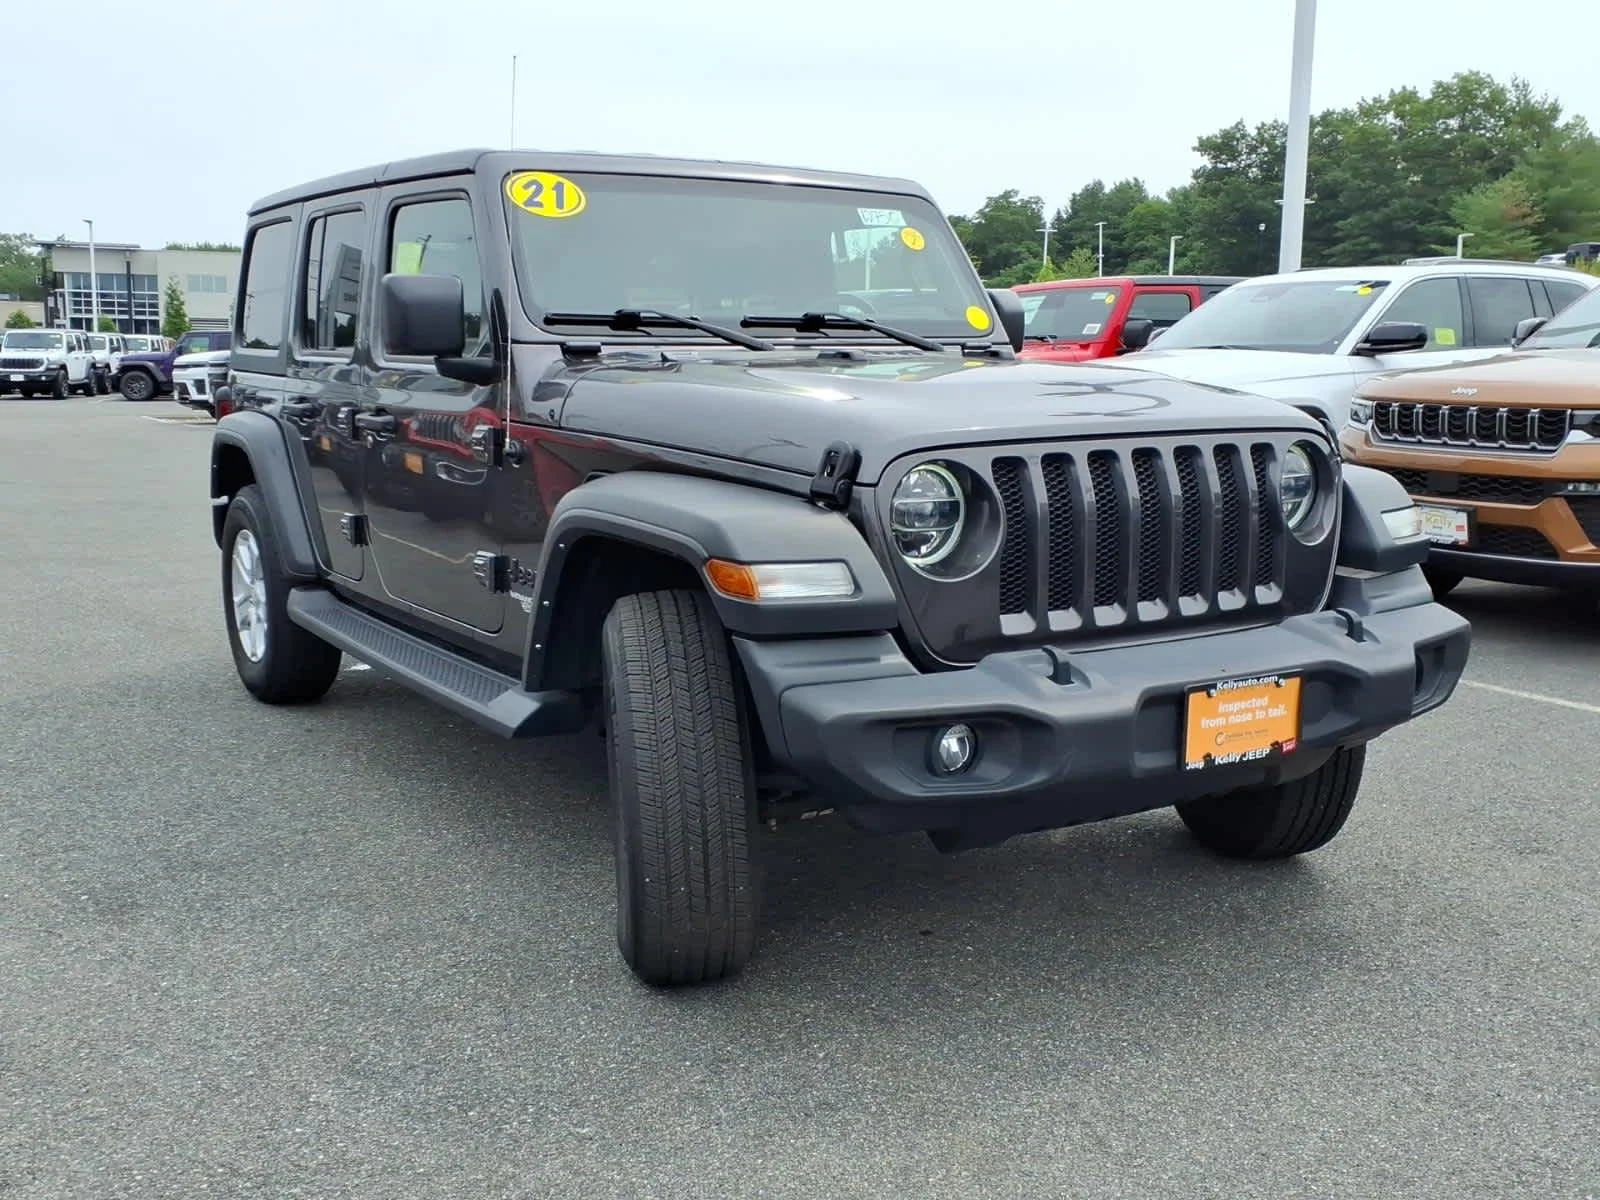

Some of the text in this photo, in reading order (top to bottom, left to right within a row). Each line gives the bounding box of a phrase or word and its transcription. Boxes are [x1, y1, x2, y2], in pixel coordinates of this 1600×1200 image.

[521, 178, 565, 210] 21
[1451, 386, 1478, 396] Jeep
[1216, 675, 1278, 691] Kellyauto.com
[1218, 696, 1269, 713] Inspected
[1201, 717, 1226, 729] from
[1228, 712, 1253, 724] nose
[1255, 709, 1266, 719] to
[1214, 747, 1270, 766] Kelly JEEP
